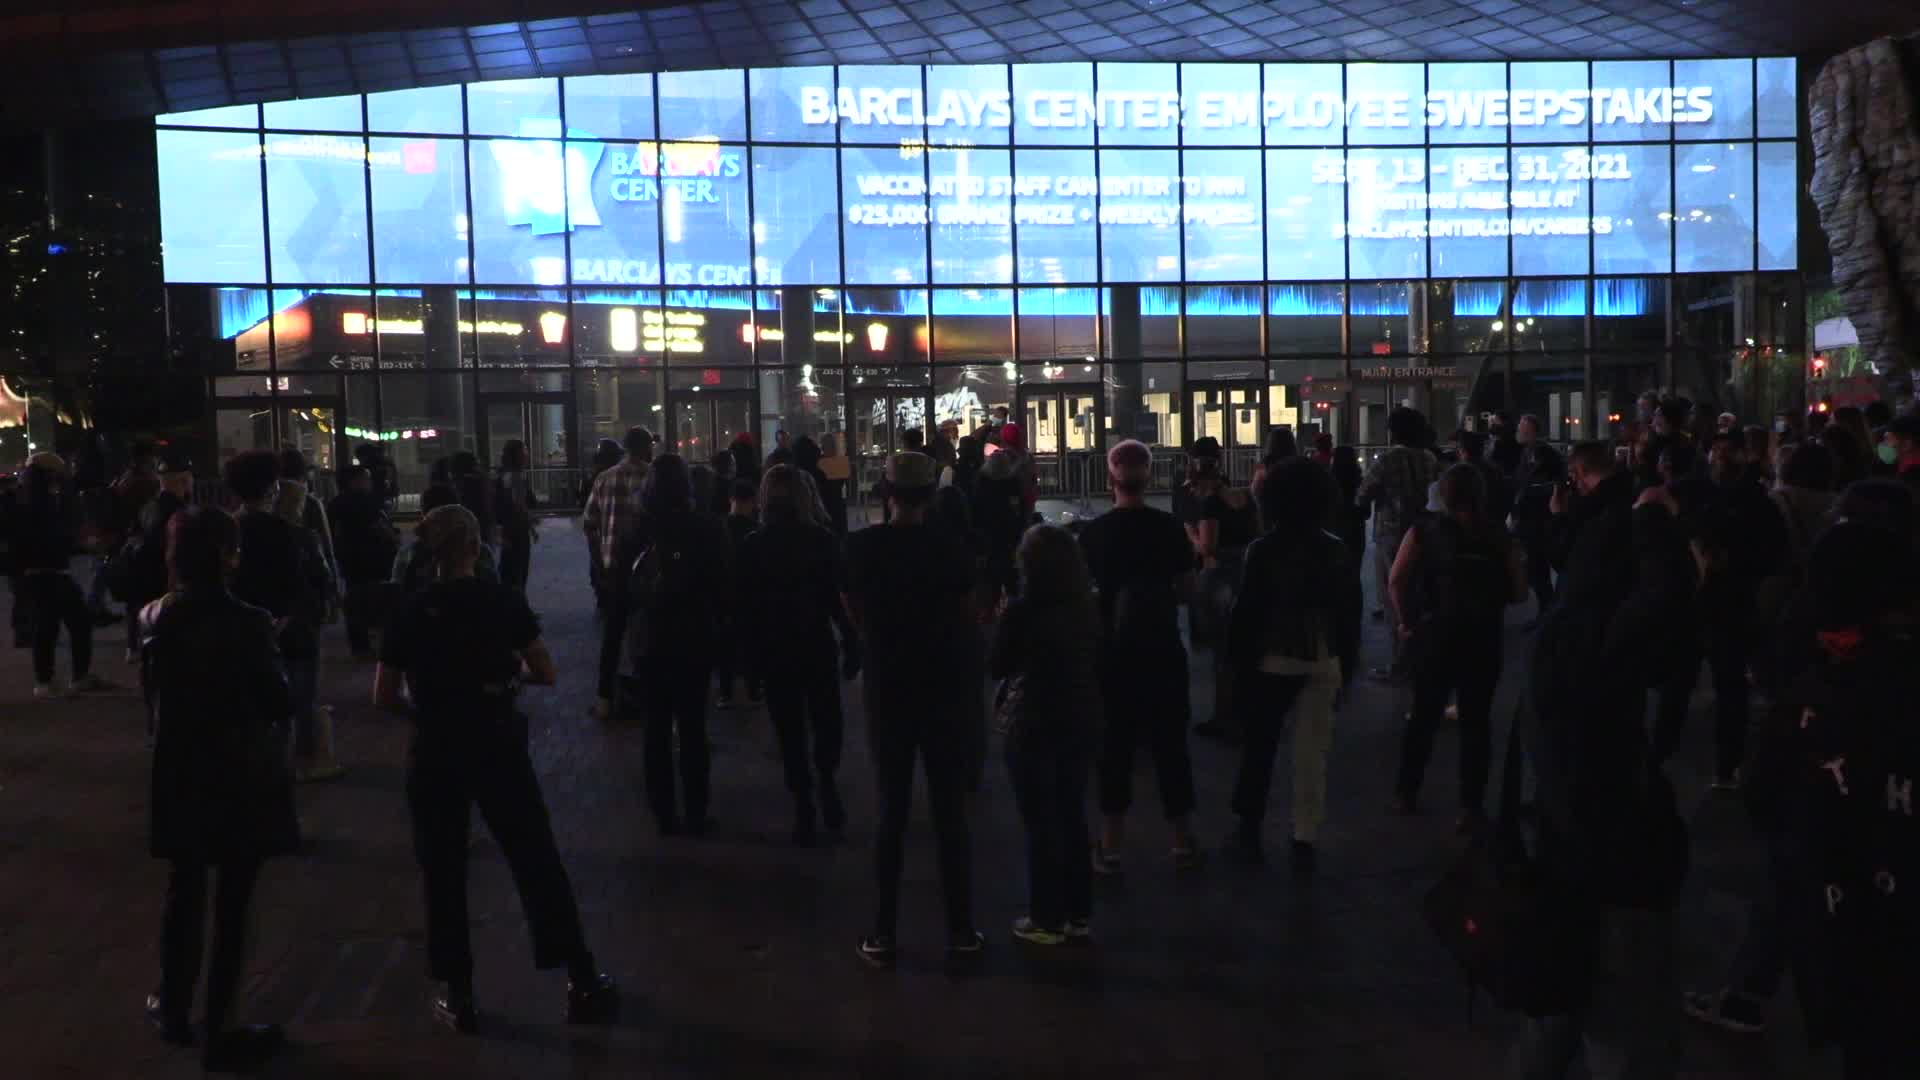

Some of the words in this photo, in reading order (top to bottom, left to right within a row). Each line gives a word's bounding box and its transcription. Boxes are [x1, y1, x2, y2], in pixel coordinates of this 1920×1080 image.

[801, 86, 1012, 126] BARCLAYS
[1026, 90, 1185, 128] CENTER
[1198, 91, 1410, 127] EMPLOYEE
[1420, 87, 1713, 126] SWEEPSTAKES
[611, 152, 739, 177] BARCLAYS
[1391, 157, 1425, 182] 13
[1518, 155, 1558, 184] 31,
[1565, 154, 1632, 180] 2021
[988, 175, 1050, 196] STAFF
[1055, 175, 1097, 196] CAN
[574, 258, 692, 284] BARCLAYS
[1361, 367, 1391, 379] MAIN
[1394, 366, 1457, 378] ENTRANCE
